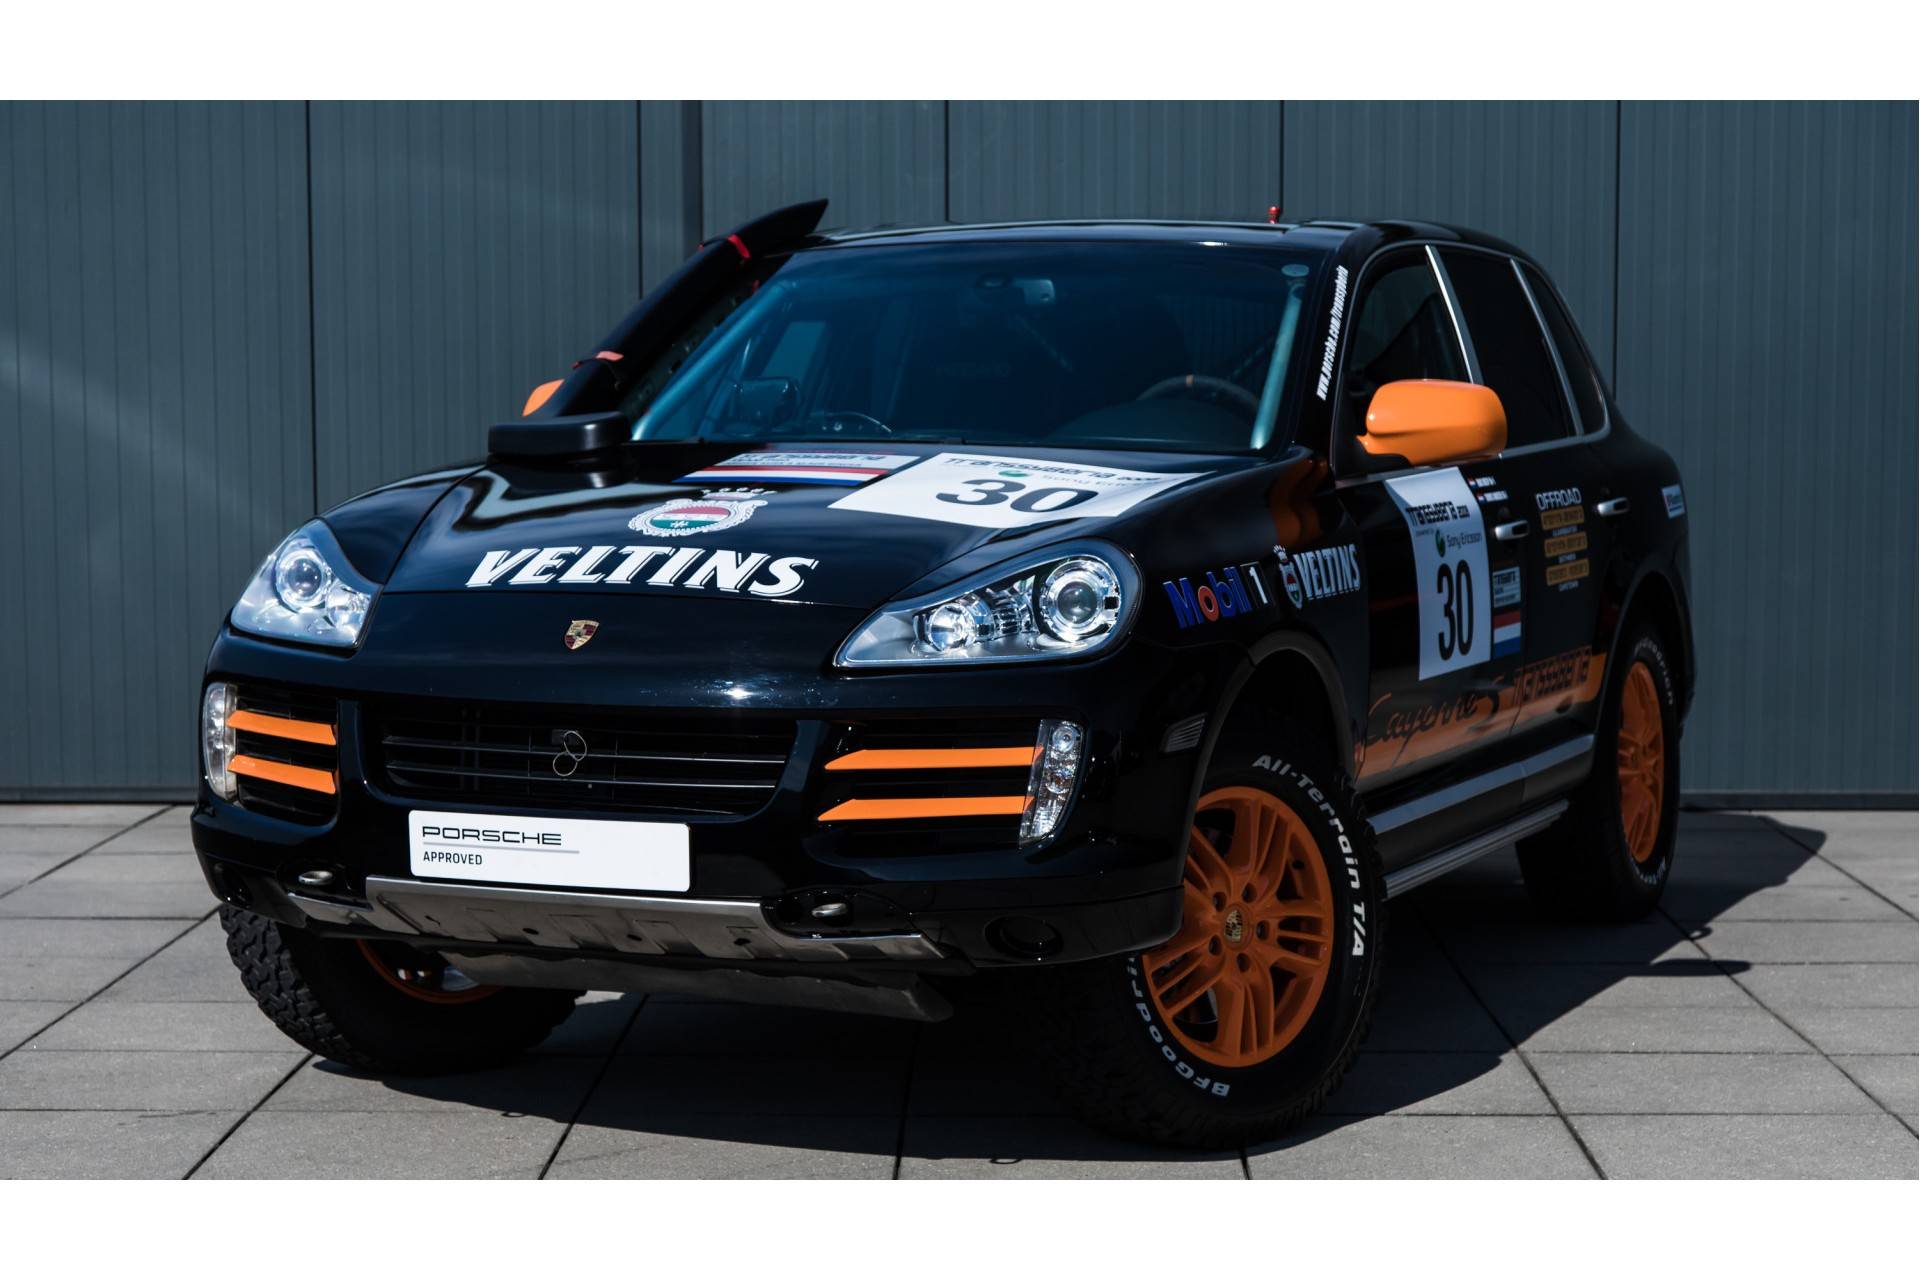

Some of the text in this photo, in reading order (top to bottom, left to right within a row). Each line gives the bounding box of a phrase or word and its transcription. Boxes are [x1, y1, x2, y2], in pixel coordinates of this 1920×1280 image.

[936, 478, 1099, 513] 30
[1536, 487, 1582, 510] OFFROAD
[1446, 531, 1482, 550] Sony Ericsson
[465, 545, 819, 597] VELTINS
[1162, 565, 1269, 628] Mobil 1
[1293, 543, 1361, 601] VELTINS
[1438, 560, 1473, 661] 30
[1362, 691, 1480, 764] Cayenne
[422, 825, 562, 846] PORSCHE
[423, 850, 483, 865] APPROVED
[1252, 754, 1367, 957] All-Terrain T/A
[1126, 956, 1231, 1097] BFGoodri
